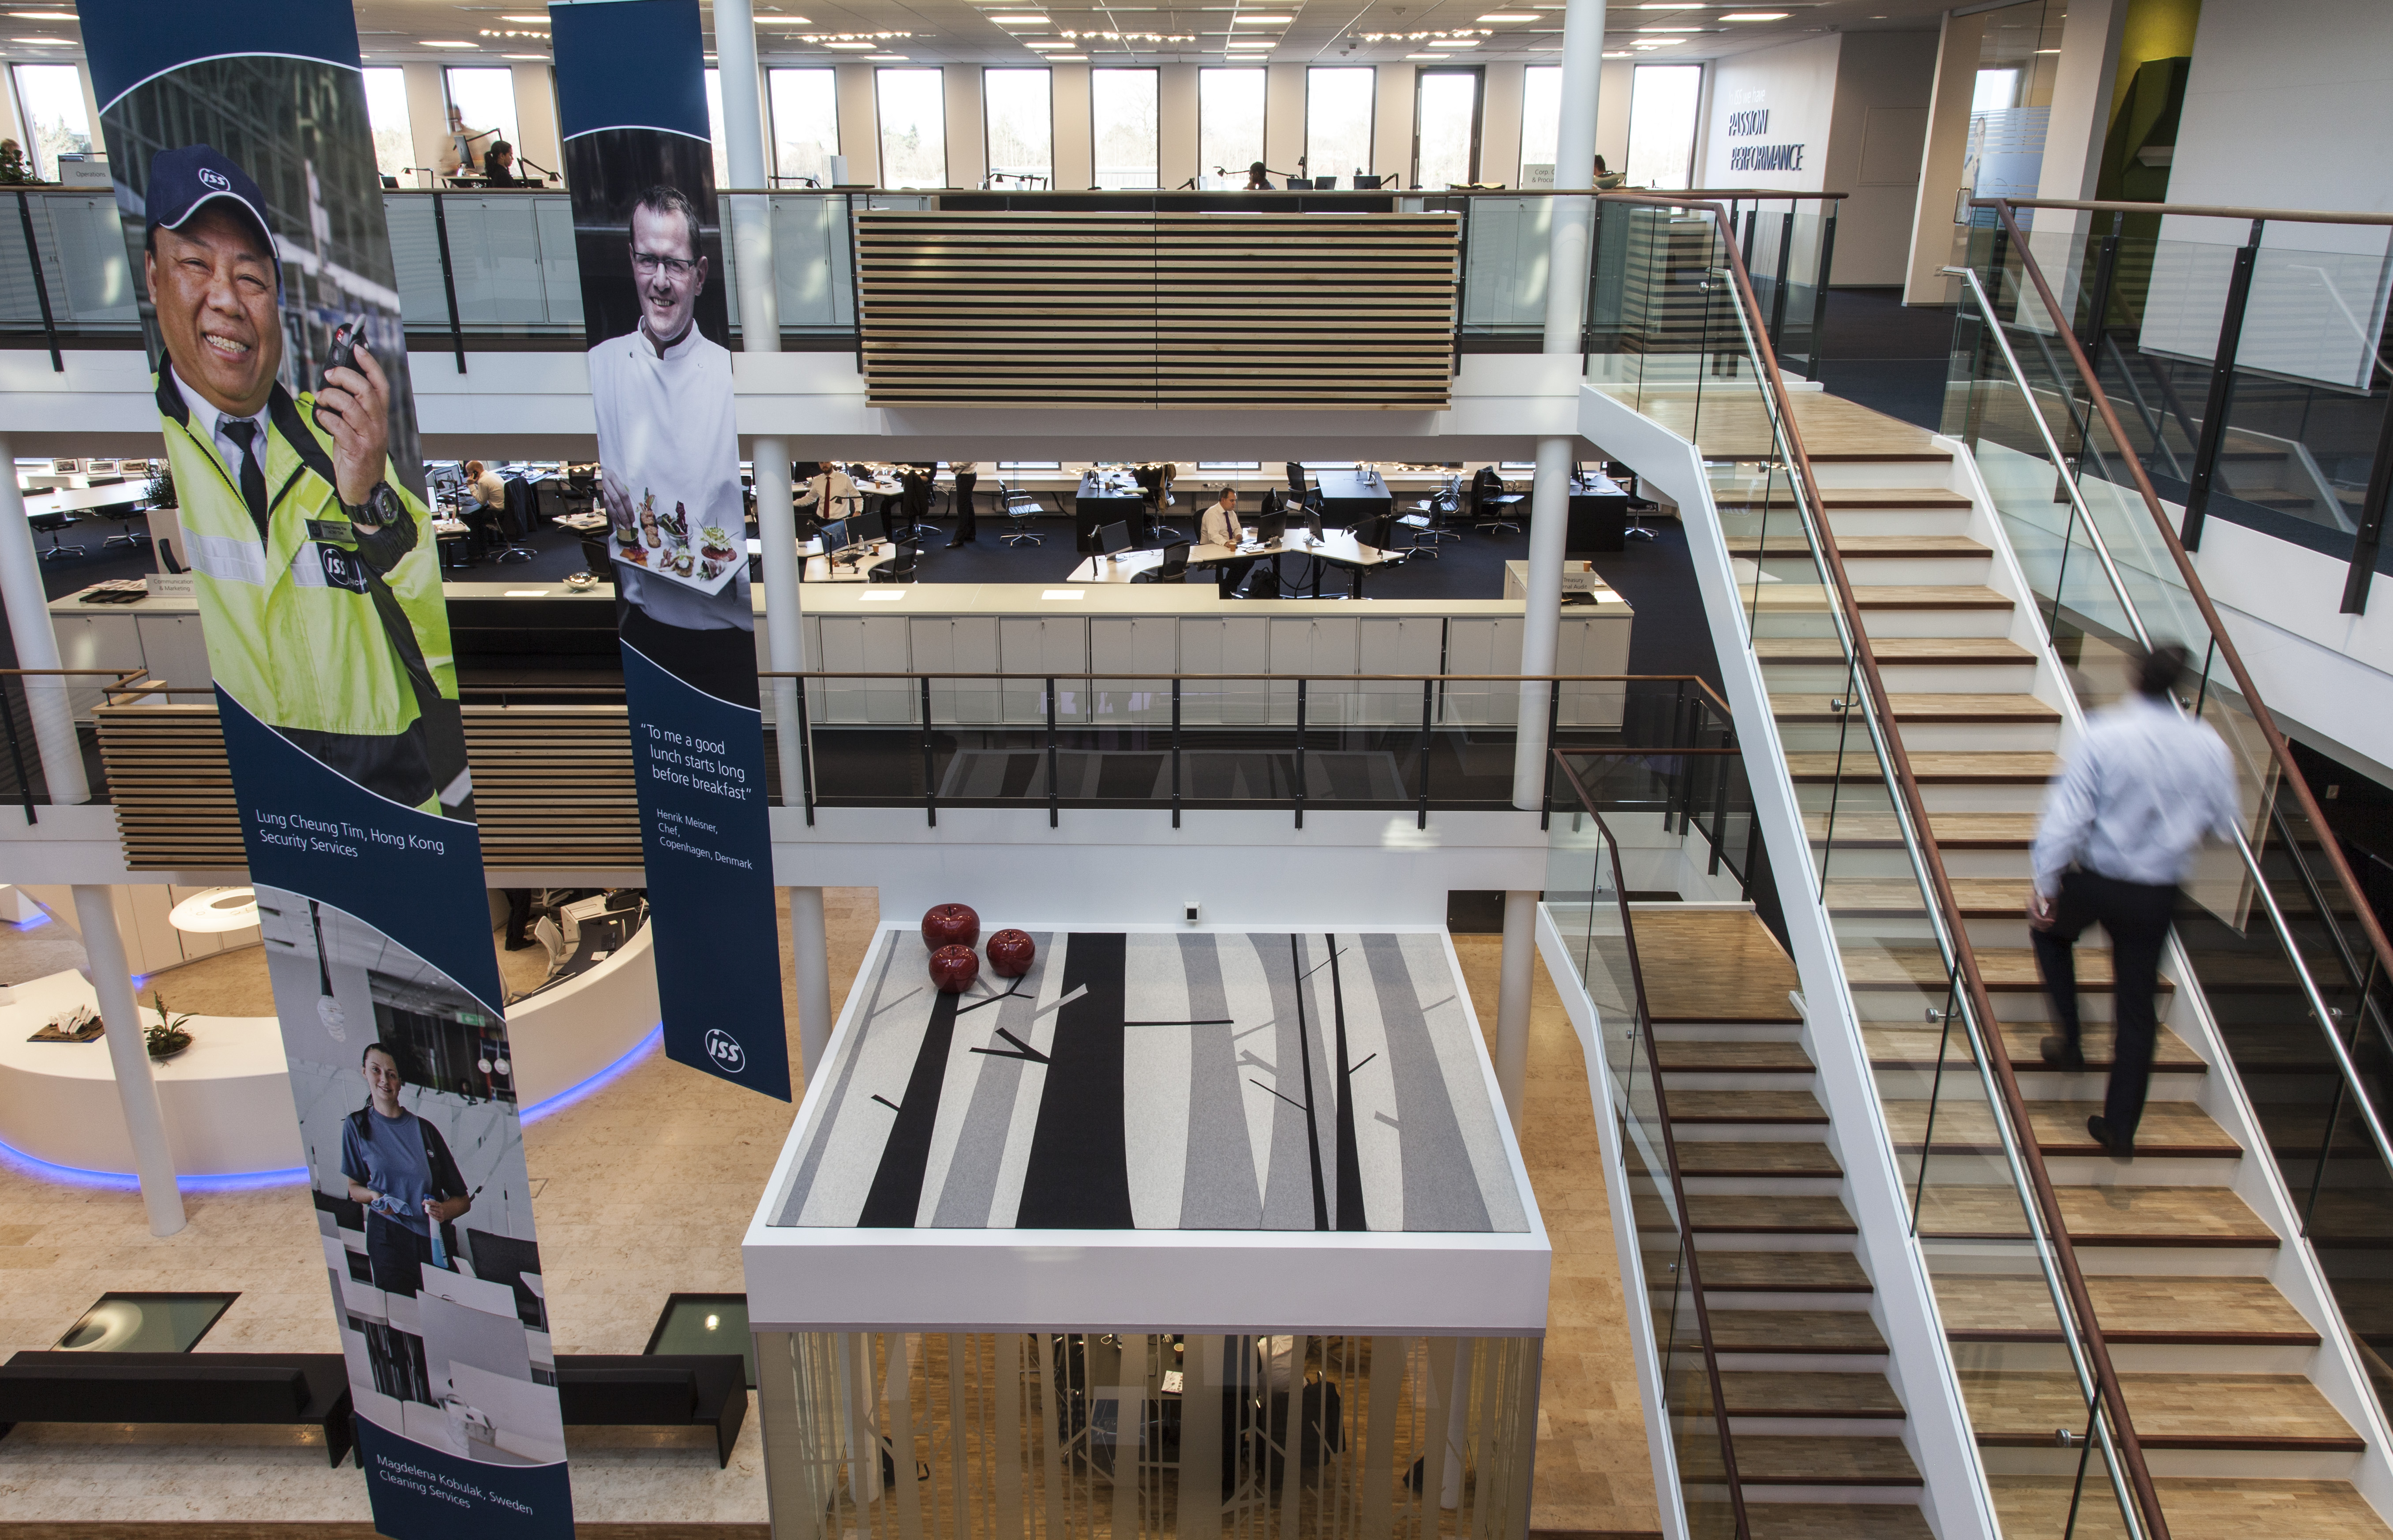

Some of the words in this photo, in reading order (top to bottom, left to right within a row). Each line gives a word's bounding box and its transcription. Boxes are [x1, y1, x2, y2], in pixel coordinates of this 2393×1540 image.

[1734, 89, 1742, 105] ISS
[1743, 91, 1751, 104] we
[1752, 86, 1765, 103] have
[1728, 109, 1769, 136] PASSION
[1730, 144, 1805, 171] PERFORMANCE
[664, 731, 682, 744] me
[685, 736, 692, 746] a
[696, 739, 725, 755] good
[650, 744, 681, 764] lunch
[685, 755, 715, 772] starts
[718, 761, 745, 782] long
[652, 764, 689, 786] before
[693, 774, 751, 800] breakfast"
[256, 809, 287, 828] Lung
[290, 815, 338, 837] Cheung
[341, 822, 367, 842] Tim,
[370, 828, 404, 849] Hong
[409, 834, 445, 855] Kong
[657, 809, 683, 824] Henrik
[685, 815, 718, 835] Meisner,
[659, 823, 680, 837] Chef,
[260, 829, 307, 851] Security
[311, 838, 358, 857] Services
[660, 837, 713, 860] Copenhagen,
[715, 851, 753, 870] Denmark
[379, 1469, 427, 1495] Cleaning
[429, 1484, 471, 1509] Services
[439, 1473, 486, 1500] Kobulak,
[489, 1491, 533, 1515] Sweden
